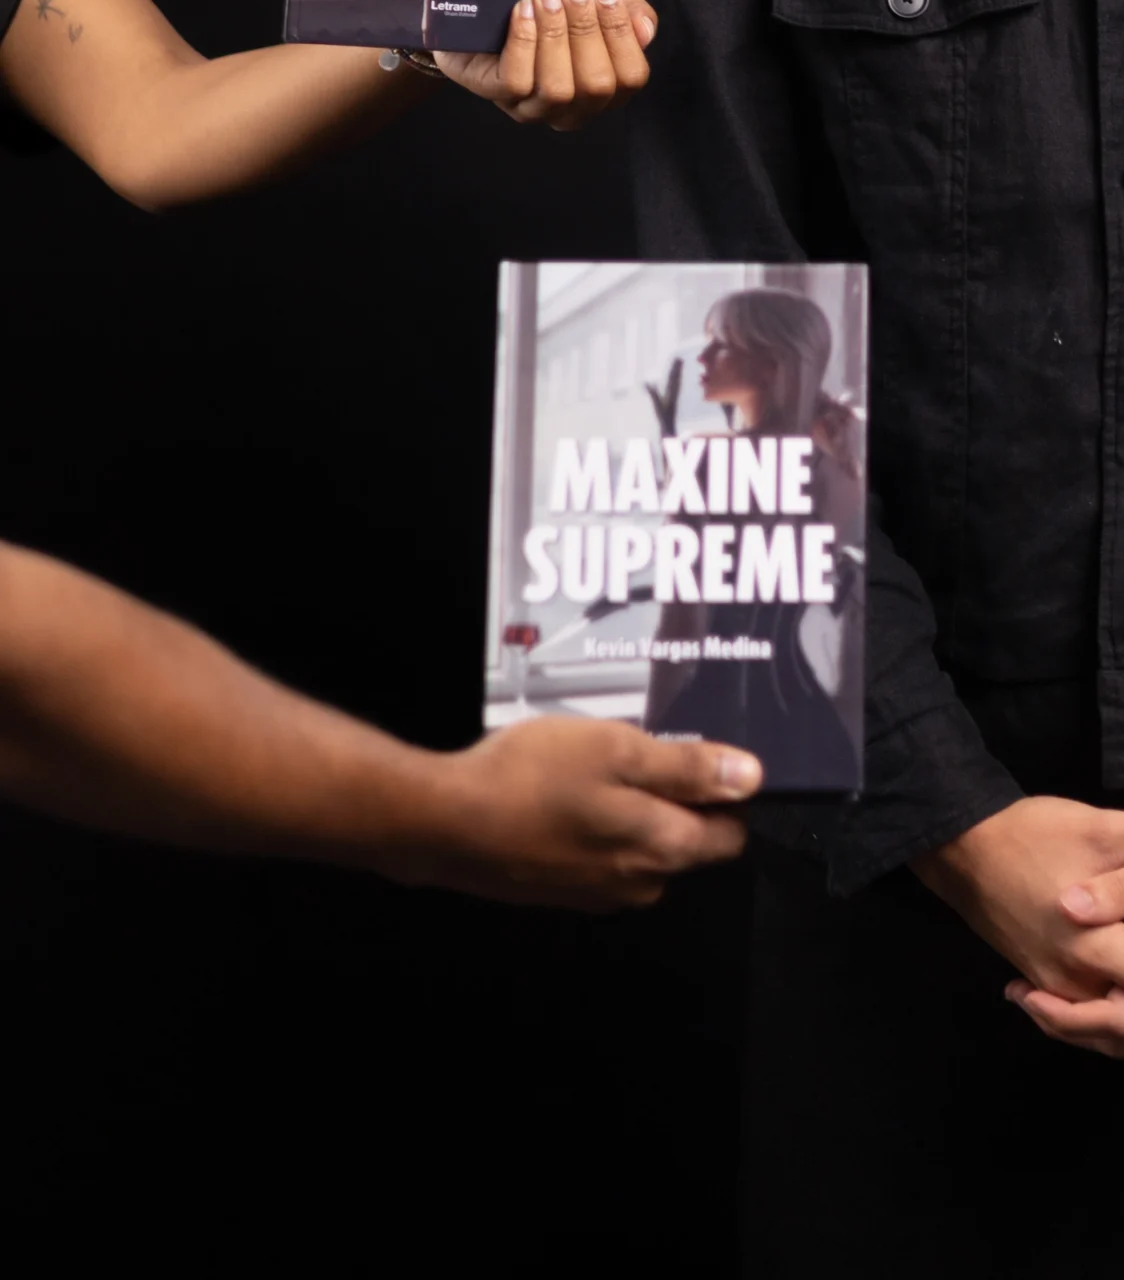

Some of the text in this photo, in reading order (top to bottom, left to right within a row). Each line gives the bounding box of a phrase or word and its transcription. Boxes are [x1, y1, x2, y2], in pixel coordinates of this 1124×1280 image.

[430, 0, 478, 13] Letrame
[548, 436, 813, 516] MAXINE
[521, 523, 836, 605] SUPREME
[584, 636, 773, 664] Kevin Vargas Medina
